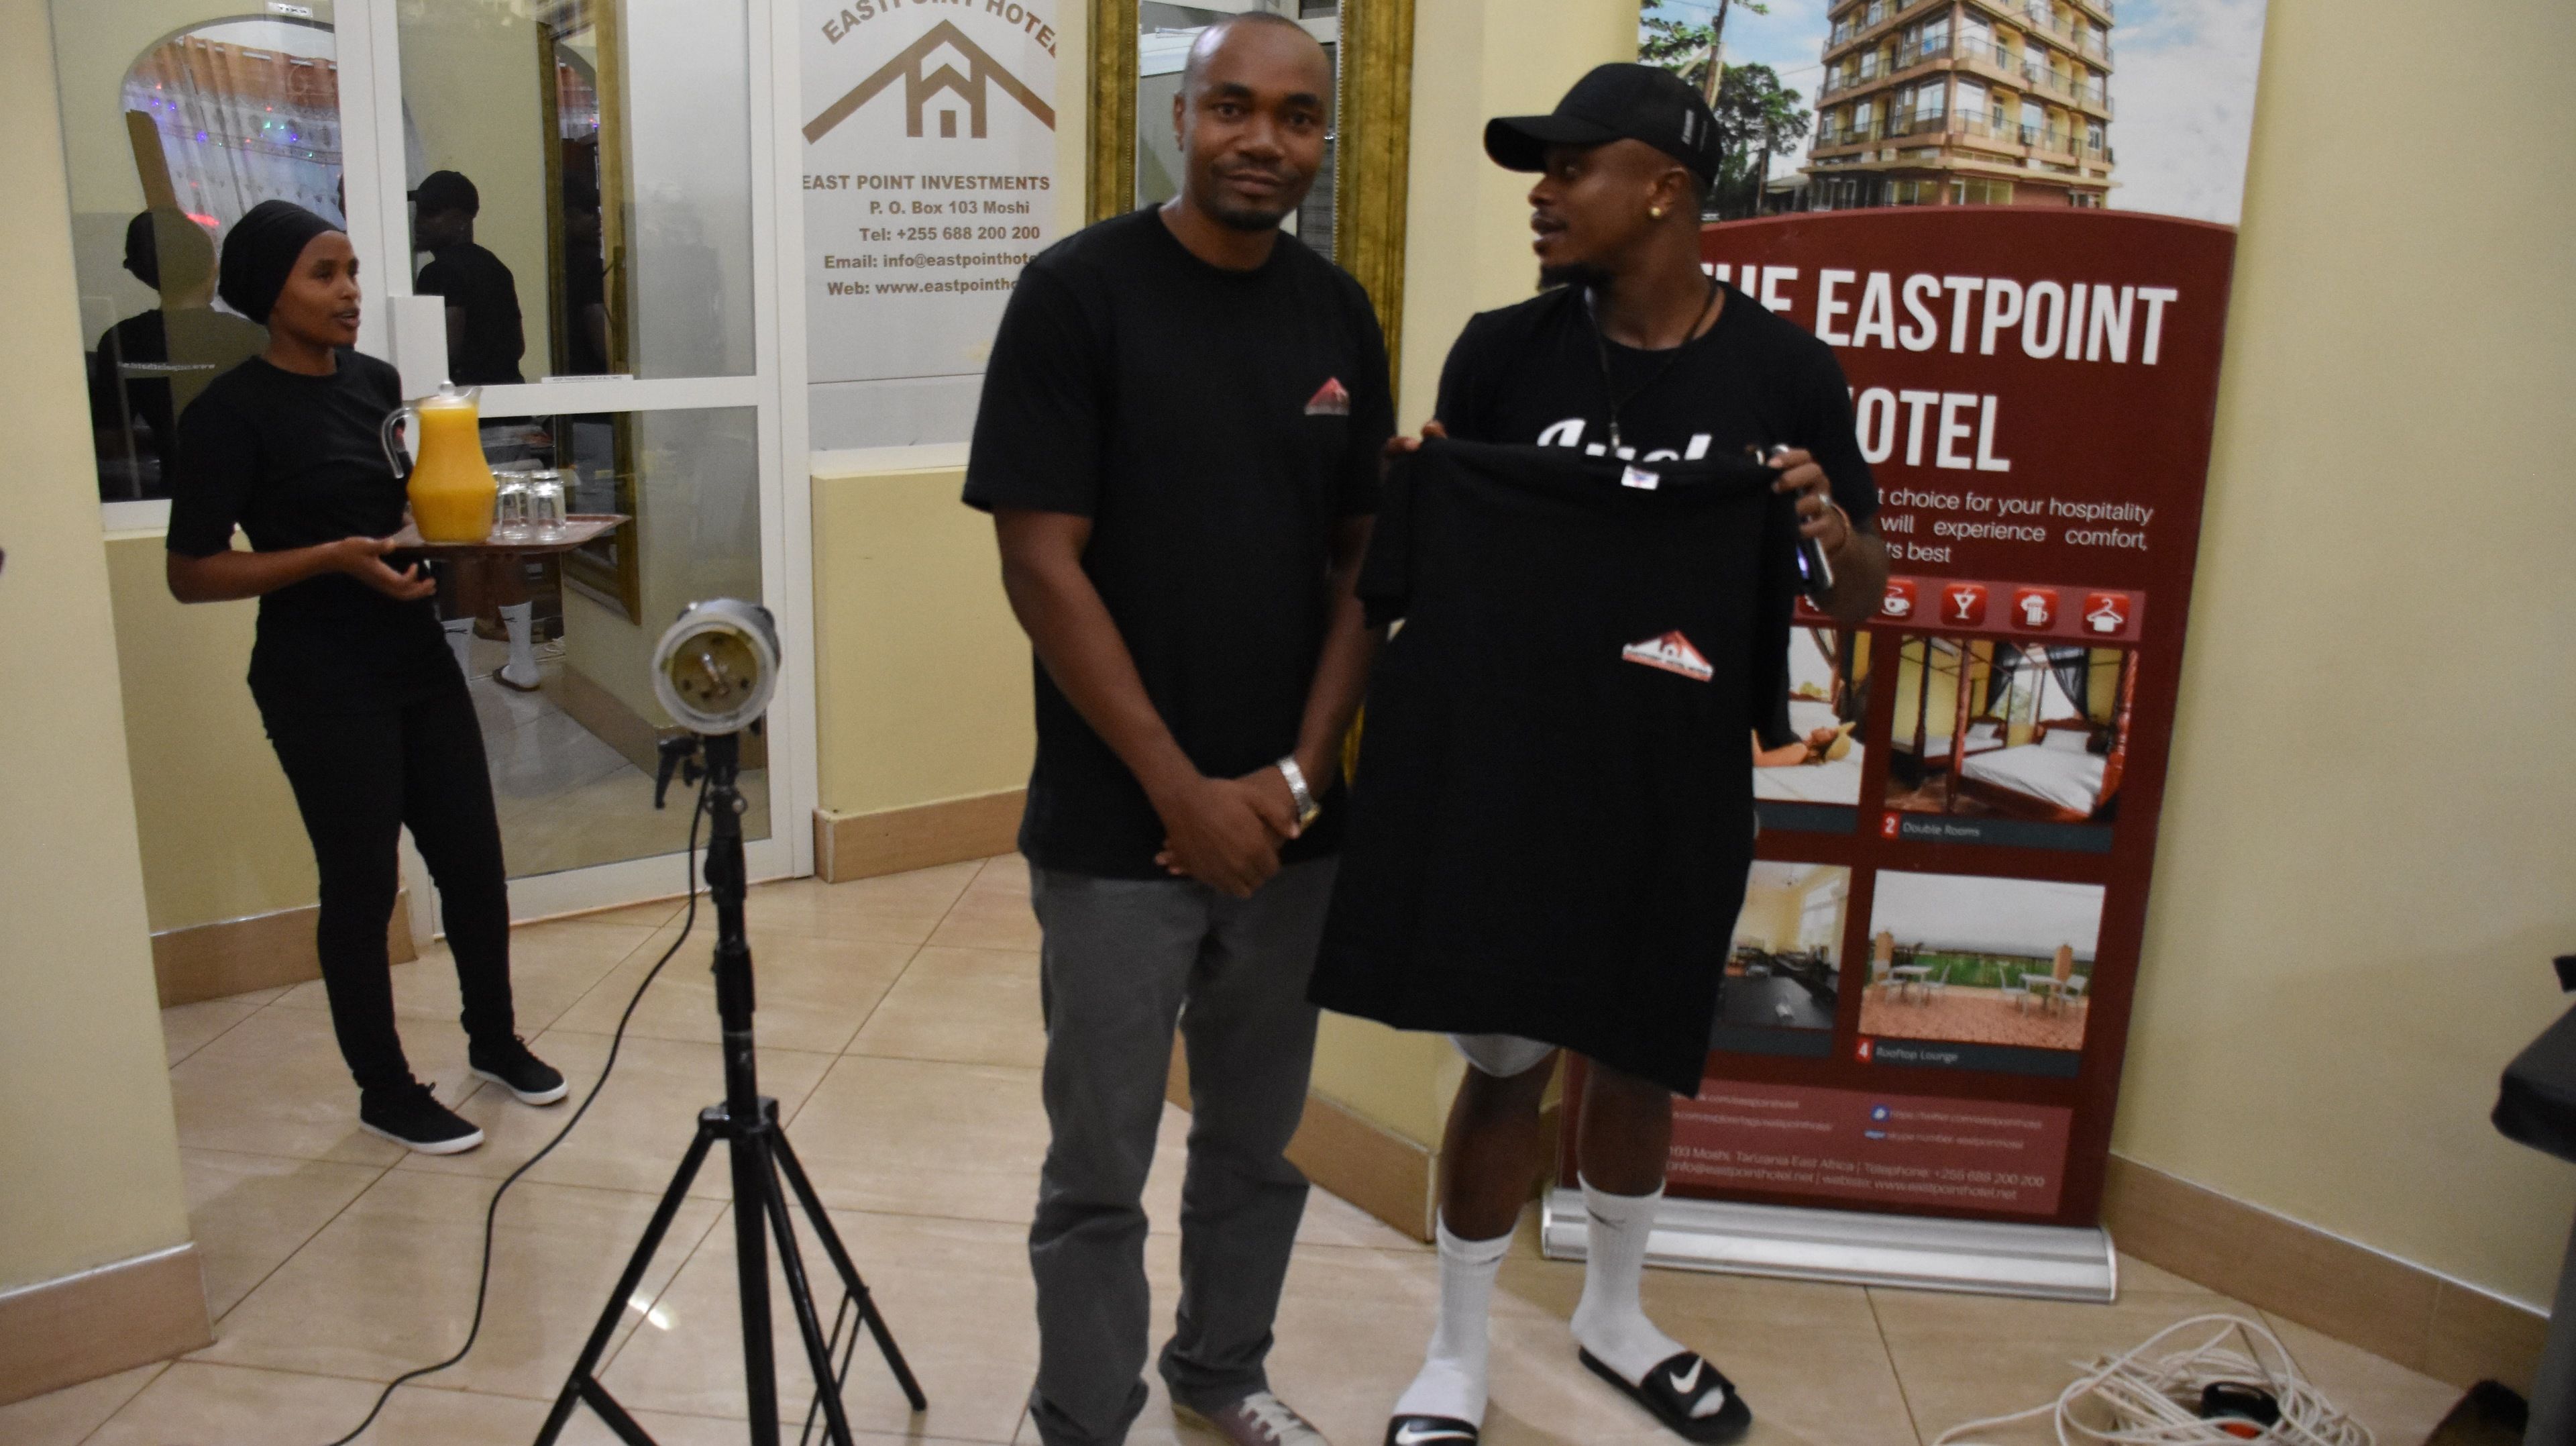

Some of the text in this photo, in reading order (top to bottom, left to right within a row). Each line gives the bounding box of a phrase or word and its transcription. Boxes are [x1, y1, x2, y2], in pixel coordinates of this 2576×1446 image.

[803, 175, 1050, 191] EAST POINT INVESTMENTS
[870, 201, 1030, 215] P. O. Box 103 Moshi
[859, 226, 1040, 242] Tel: +255 688 200 200
[824, 252, 1038, 269] Email: info@eastpointhote
[827, 281, 870, 295] Web:
[1815, 268, 2179, 366] EASTPOINT
[1847, 386, 2011, 472] OTEL
[1889, 487, 1960, 510] choice
[1965, 491, 1993, 511] for
[1997, 498, 2045, 517] your
[2049, 497, 2155, 527] hospitality
[1880, 515, 2147, 551] will experience comfort,
[1907, 541, 1951, 563] best
[1884, 816, 1896, 833] 2
[1902, 822, 1942, 835] Double
[1858, 1042, 1868, 1058] 4
[1920, 1051, 1958, 1064] Lounge
